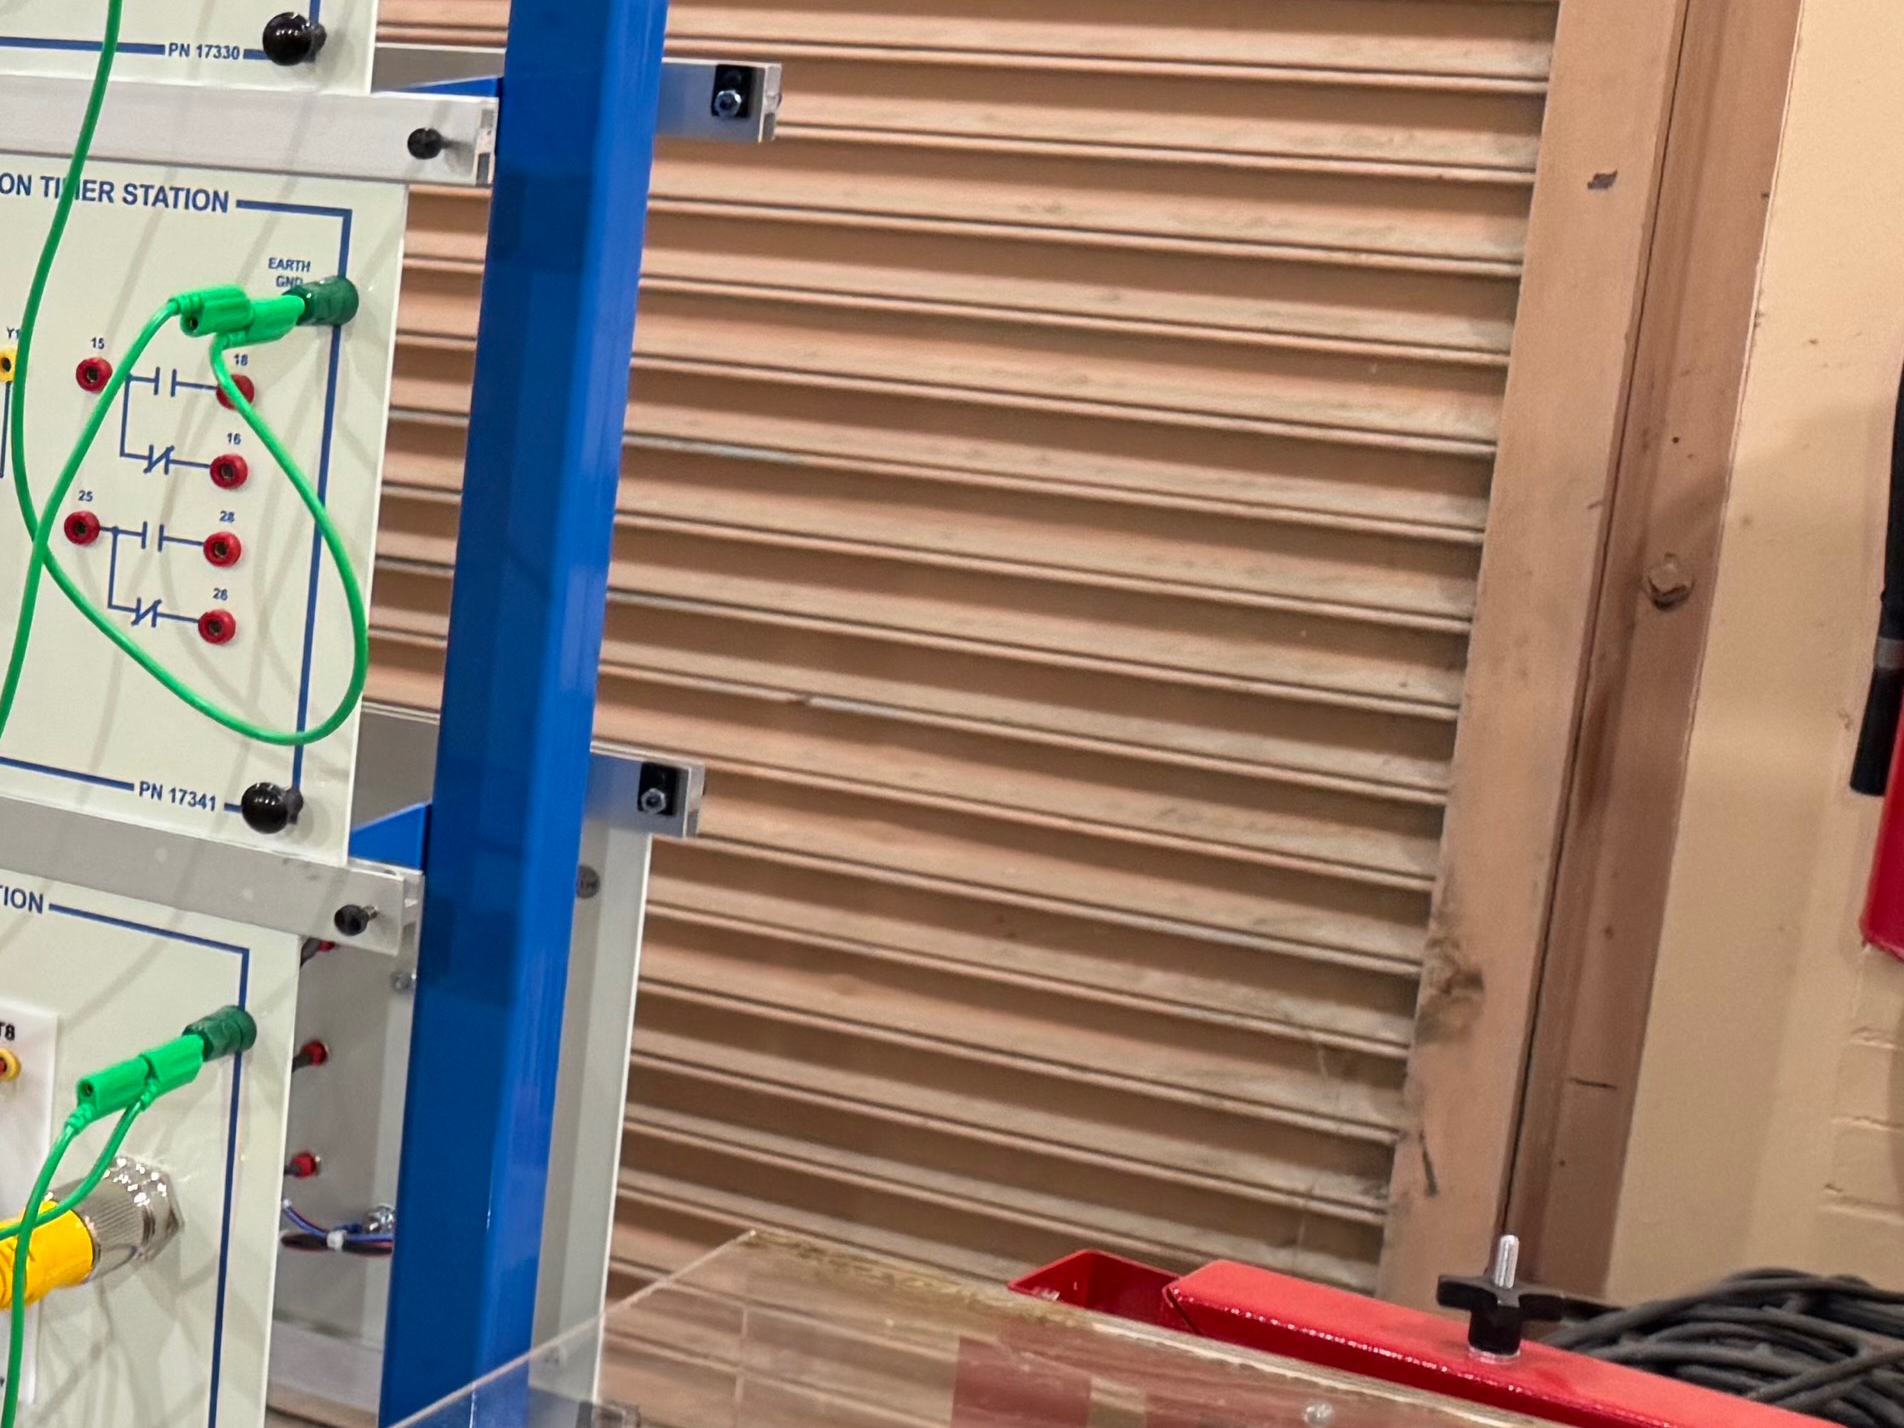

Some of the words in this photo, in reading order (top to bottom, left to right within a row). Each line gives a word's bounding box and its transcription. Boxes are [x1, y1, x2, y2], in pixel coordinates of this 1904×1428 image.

[168, 42, 190, 59] PN
[195, 44, 241, 61] 17330
[40, 176, 115, 204] TIER
[122, 183, 229, 213] STATION
[268, 257, 311, 273] EARTH
[90, 336, 105, 350] 15
[226, 432, 241, 445] 16
[78, 490, 93, 502] 25
[138, 781, 163, 801] PN
[168, 788, 216, 812] 17341
